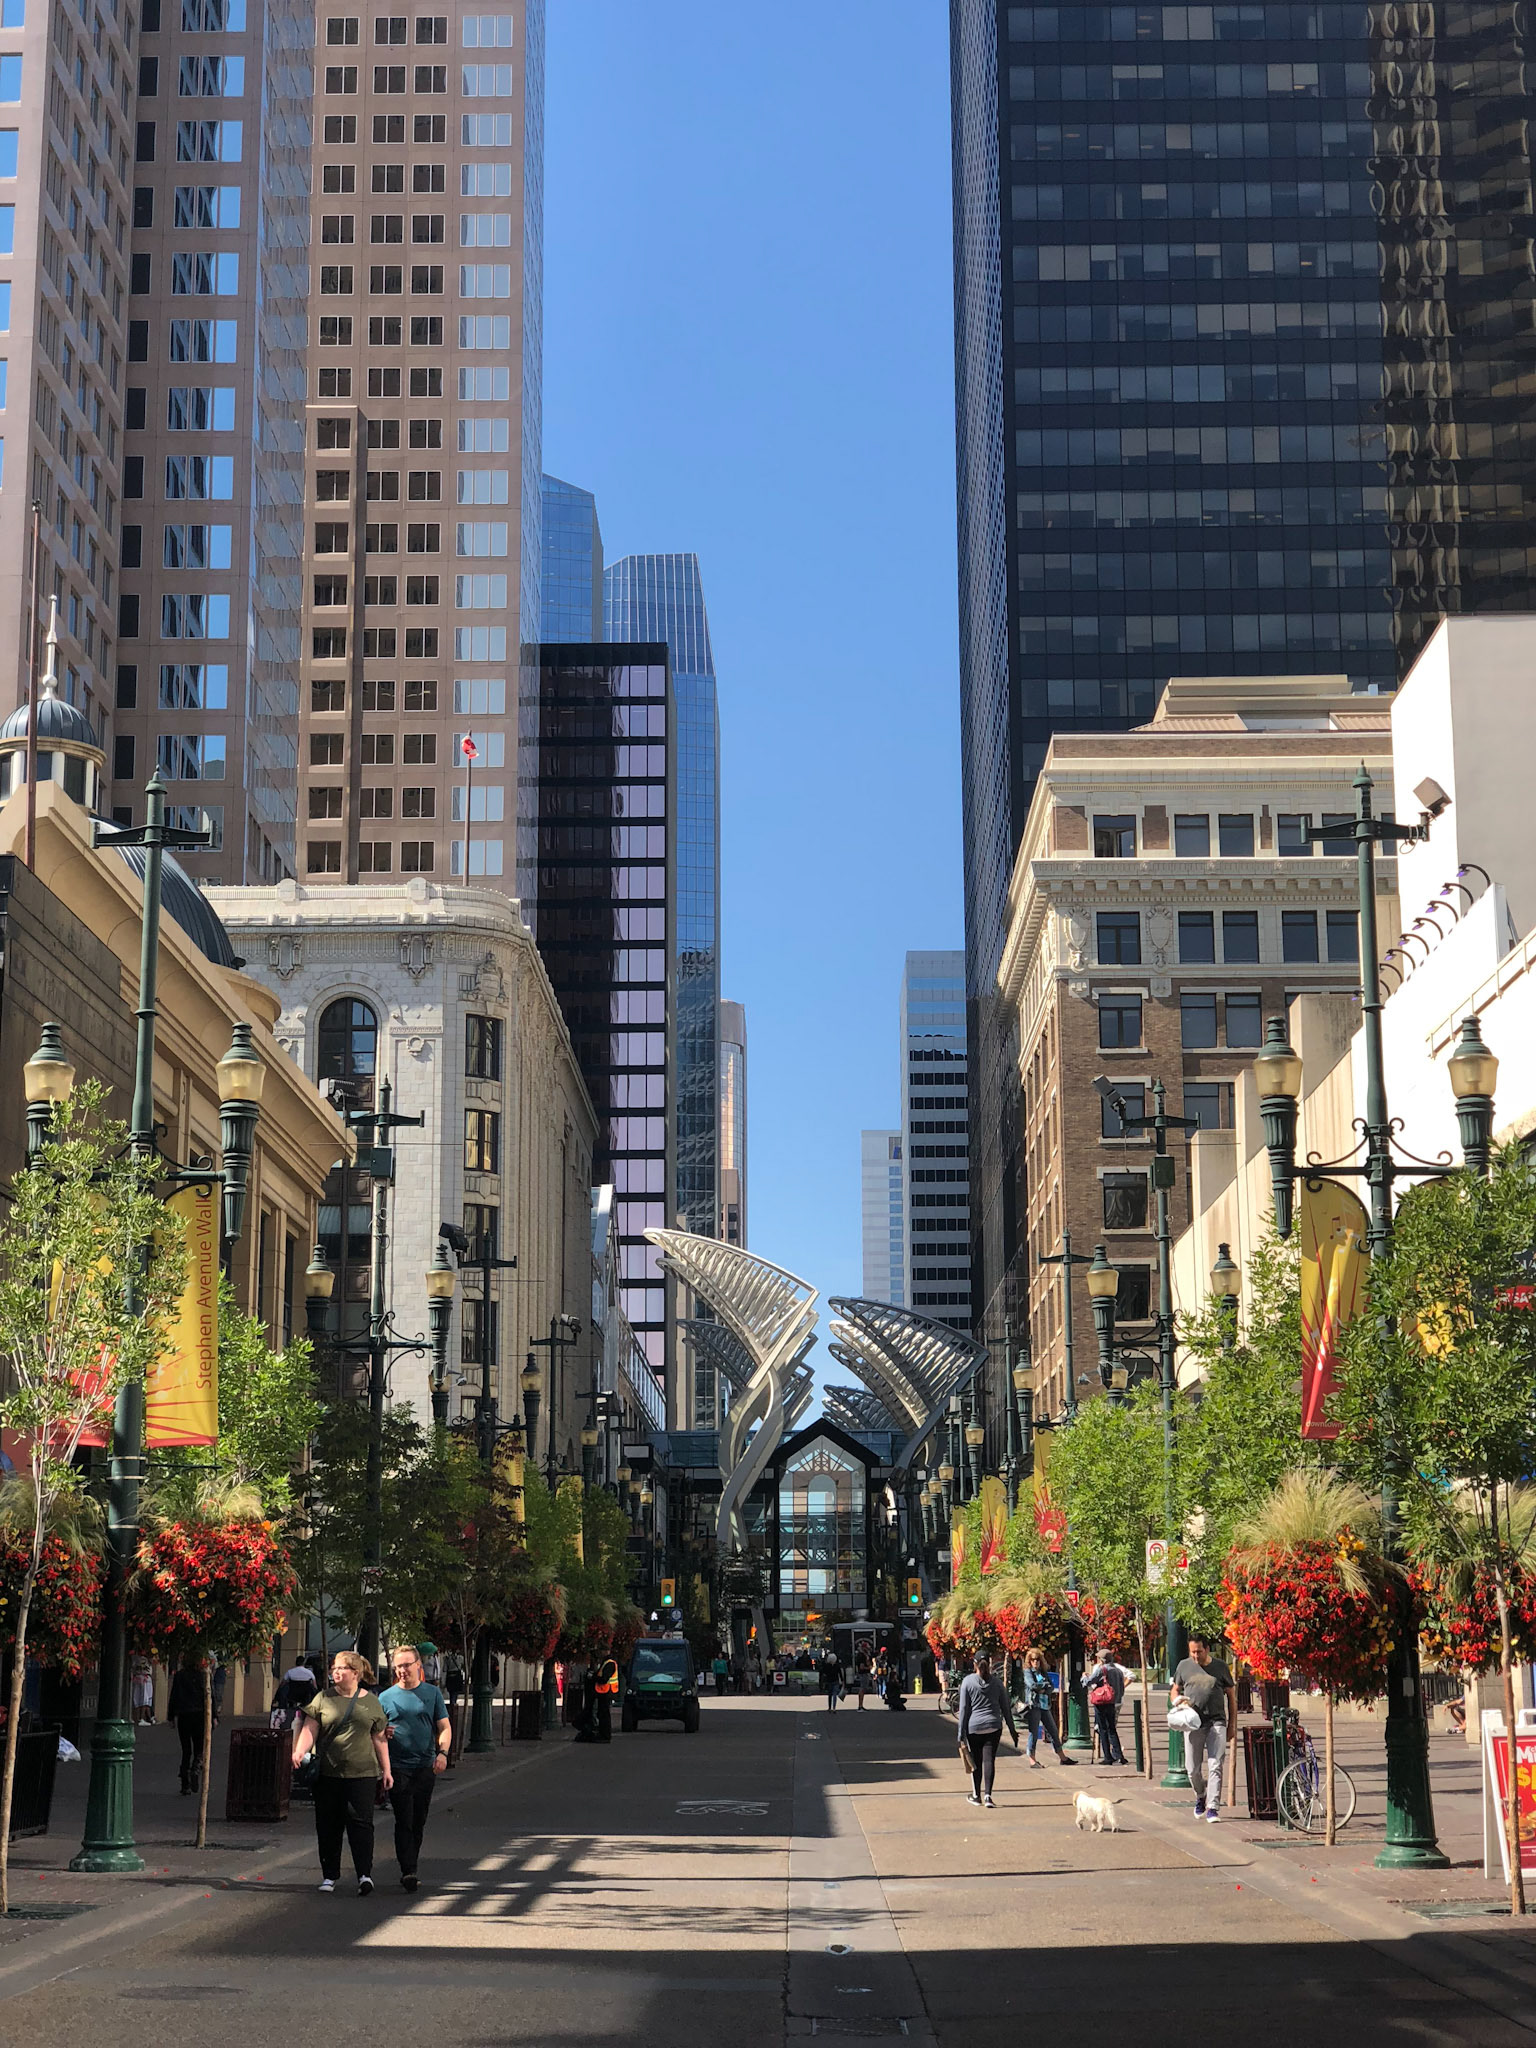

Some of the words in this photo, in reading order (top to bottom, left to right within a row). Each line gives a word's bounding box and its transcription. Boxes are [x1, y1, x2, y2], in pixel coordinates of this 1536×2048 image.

[196, 1240, 212, 1309] Avenue
[195, 1314, 215, 1390] Stephen
[514, 1457, 522, 1486] venue
